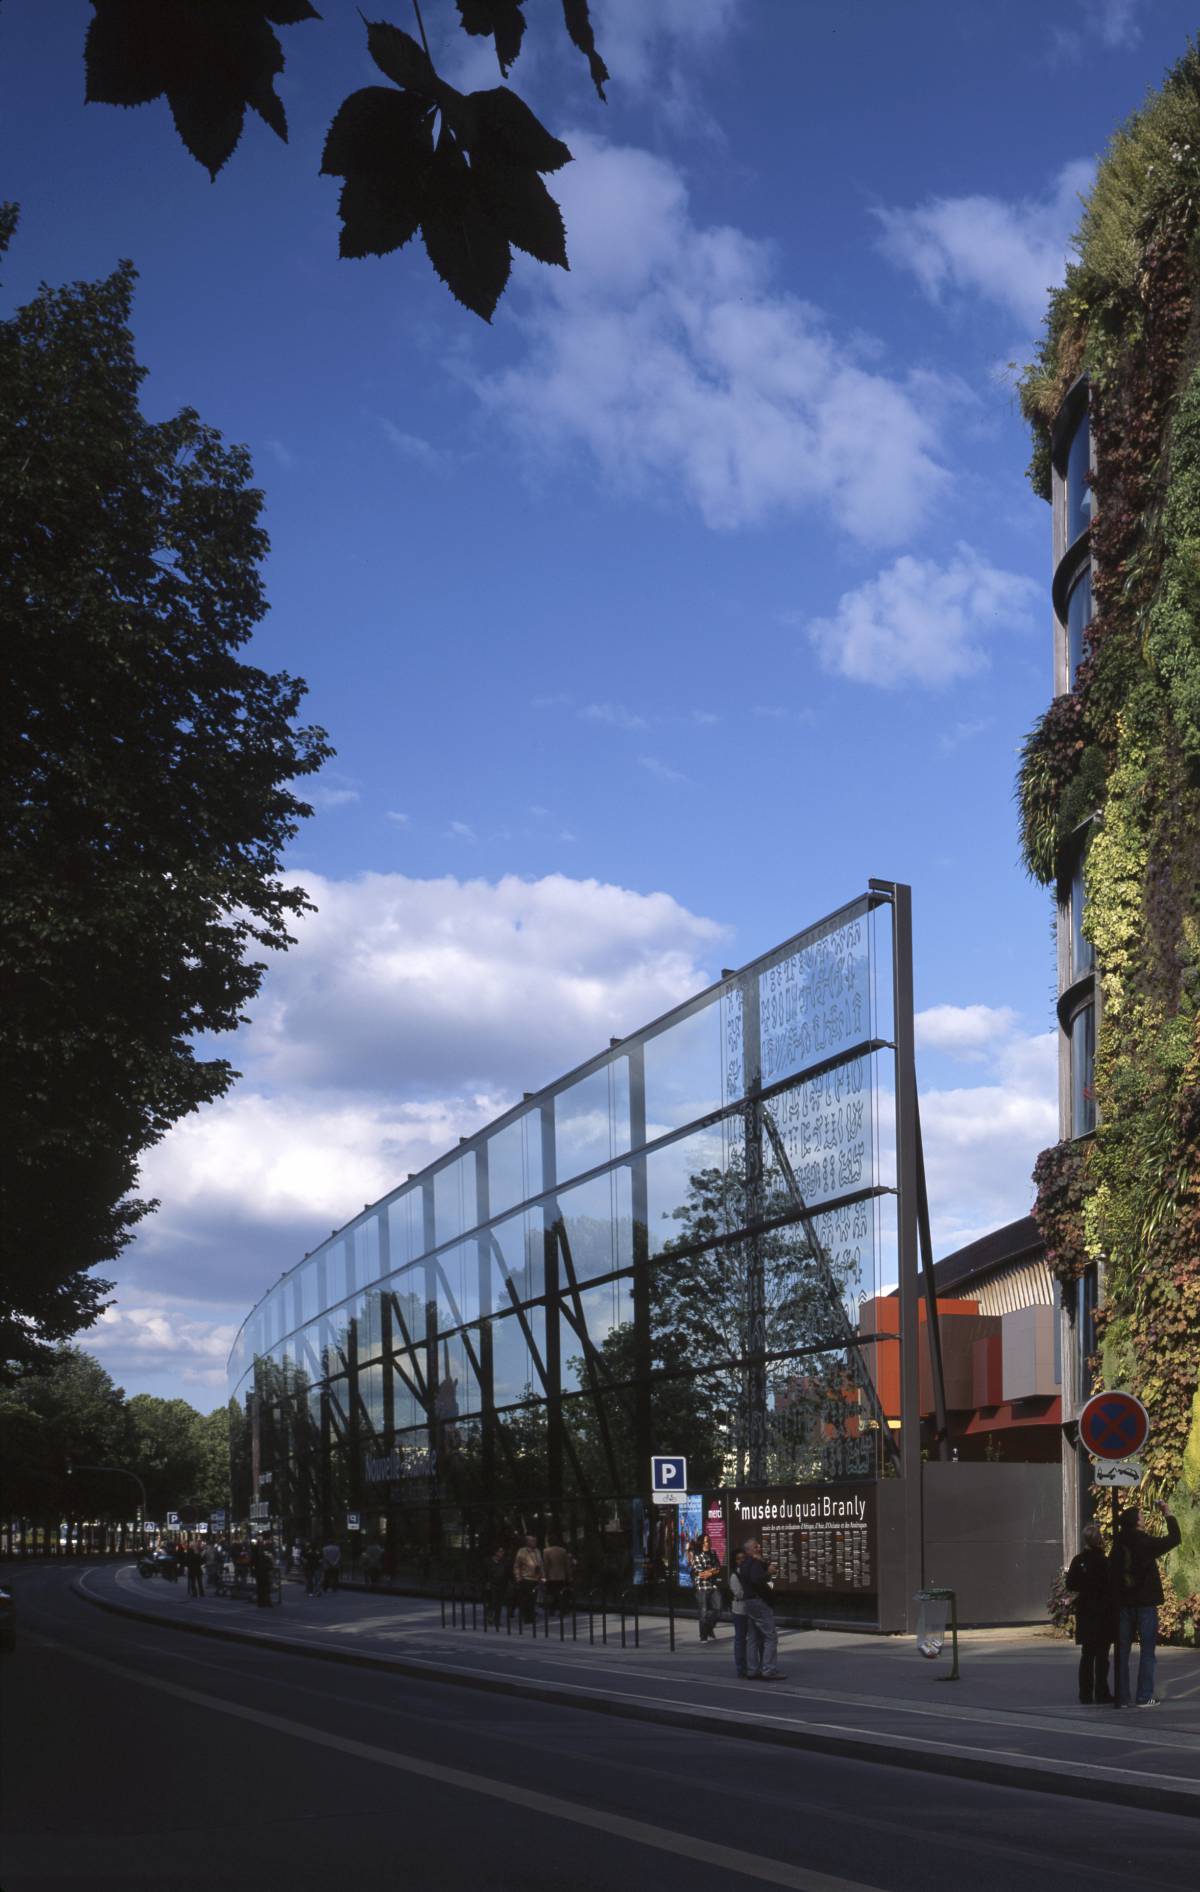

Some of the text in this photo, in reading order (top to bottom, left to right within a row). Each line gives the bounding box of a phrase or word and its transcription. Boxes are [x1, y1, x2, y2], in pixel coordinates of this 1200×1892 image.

[661, 1463, 677, 1485] P
[708, 1506, 722, 1519] merci
[741, 1495, 866, 1523] musée du quai Branly
[170, 1514, 178, 1524] P
